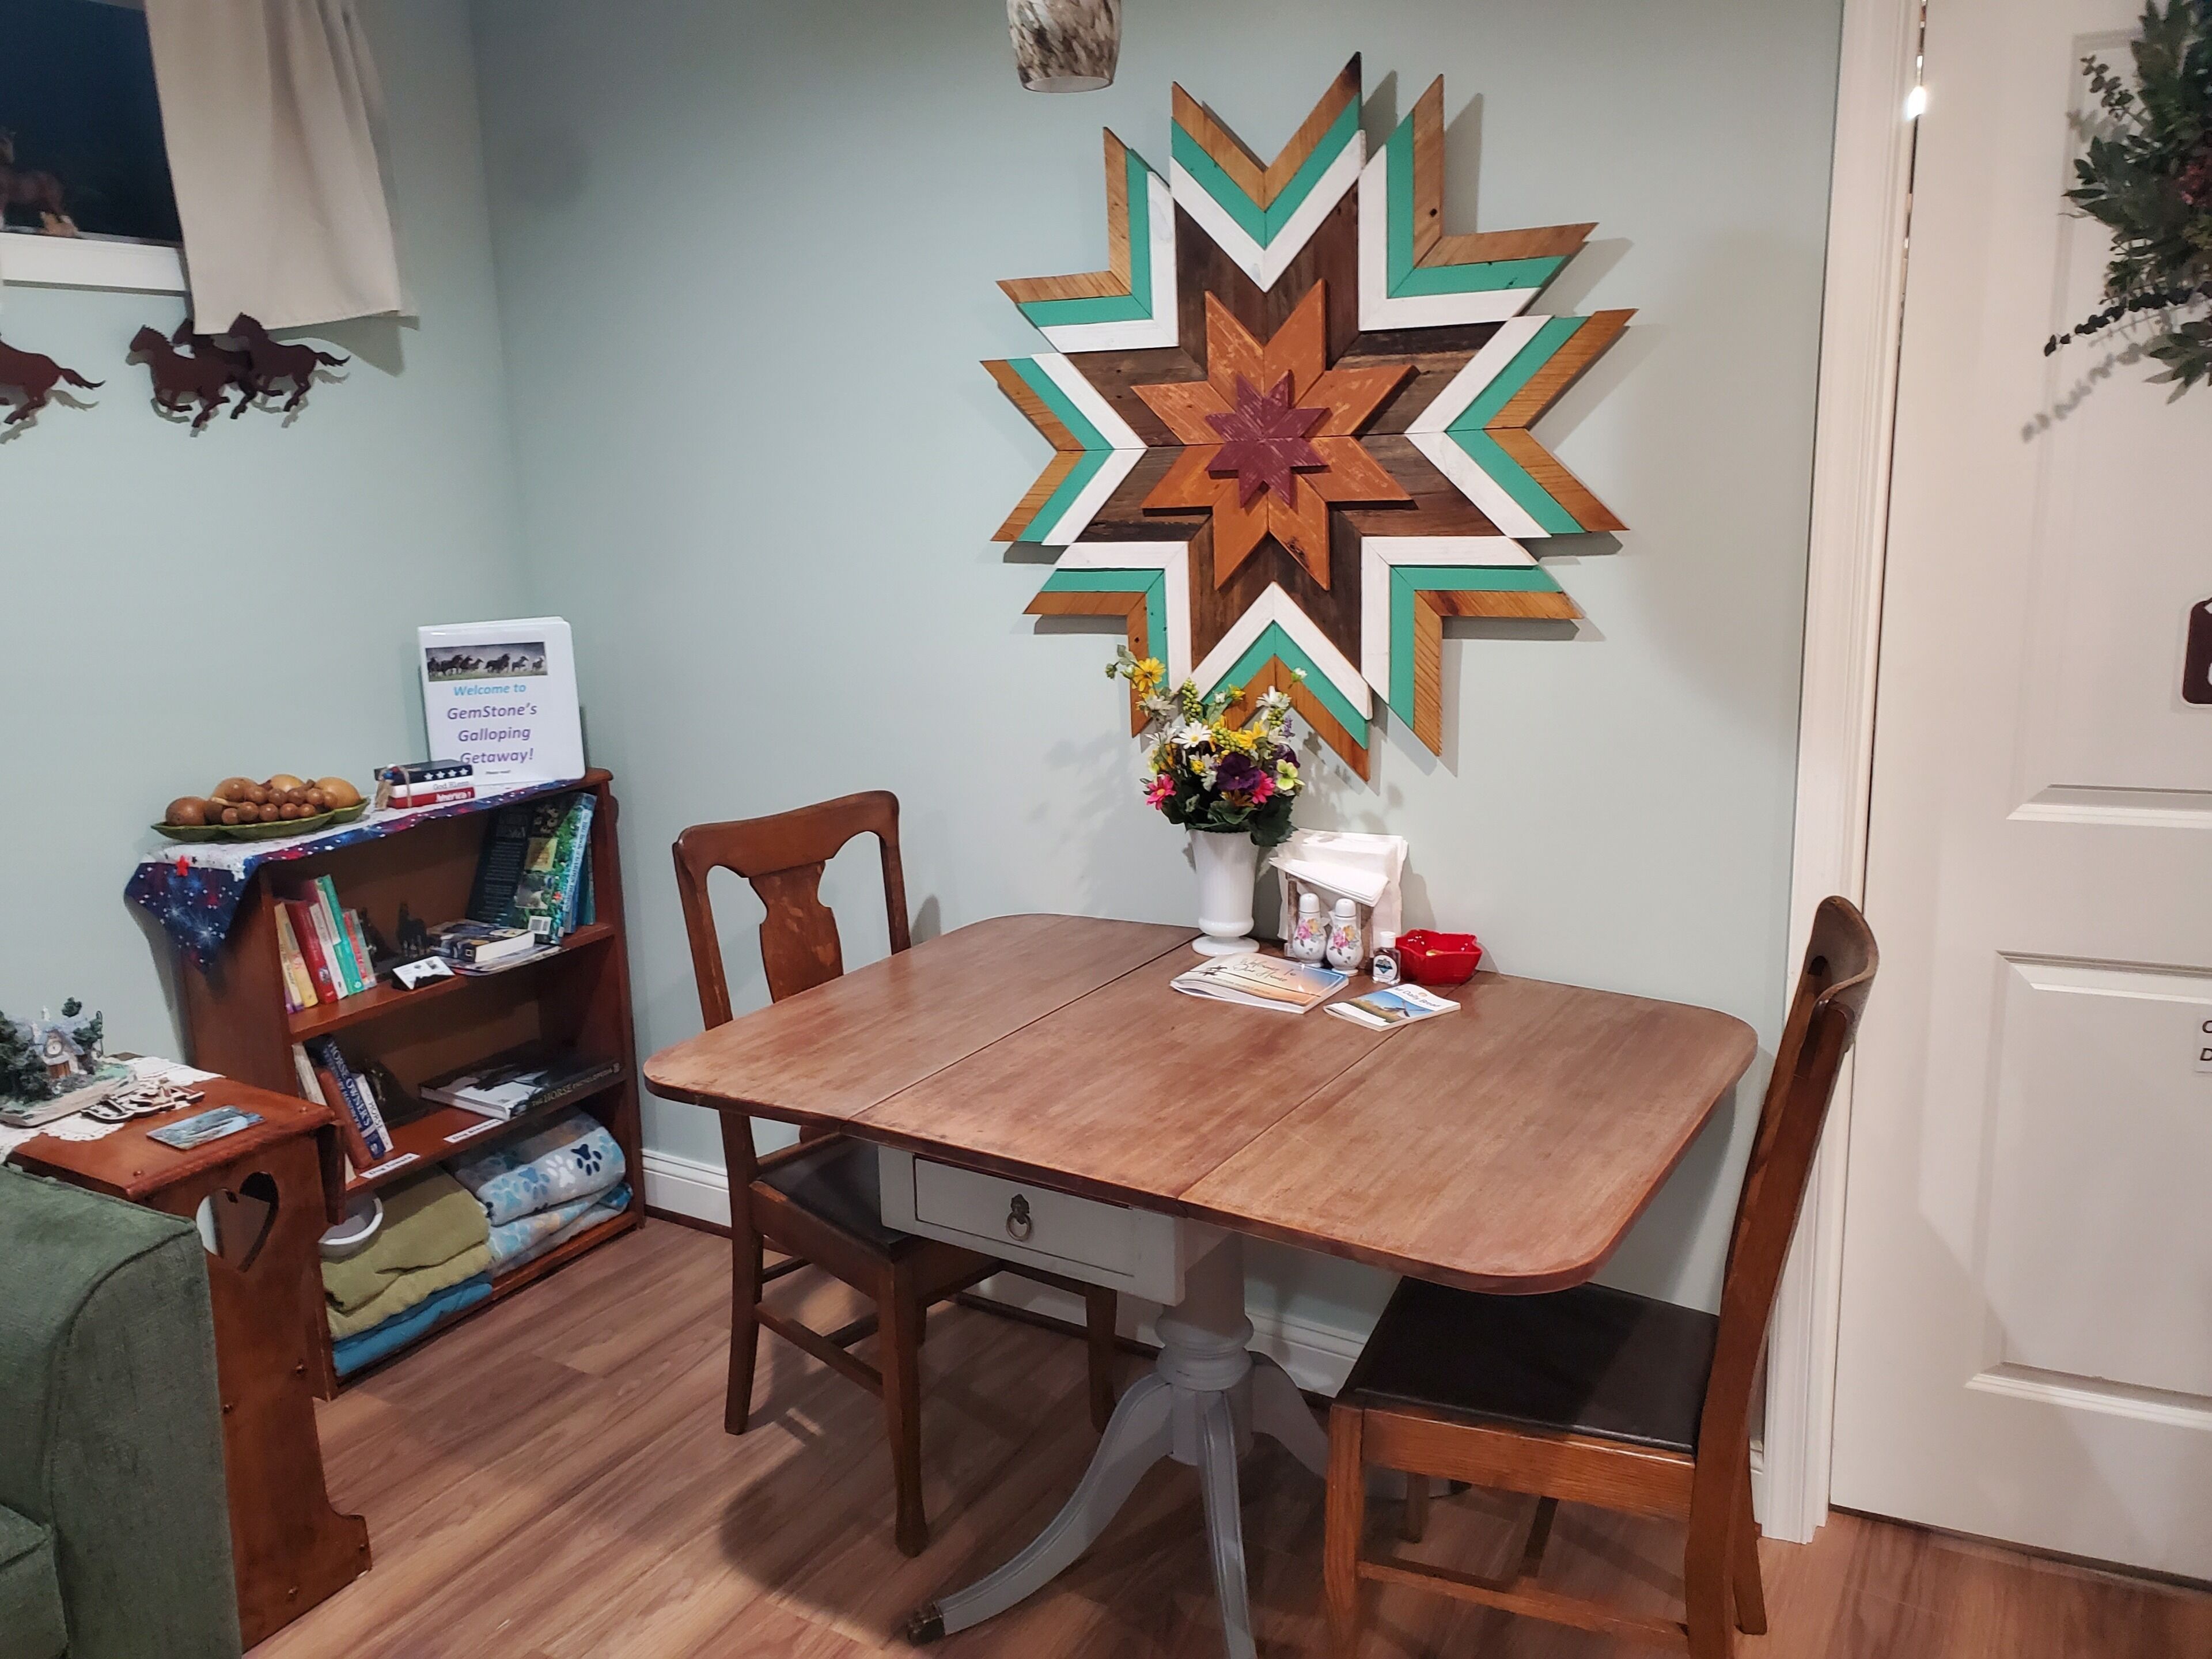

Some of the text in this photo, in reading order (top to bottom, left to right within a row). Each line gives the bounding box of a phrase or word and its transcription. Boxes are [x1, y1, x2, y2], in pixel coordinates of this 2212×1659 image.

[453, 684, 526, 696] Welcome to
[458, 726, 531, 742] Galloping
[460, 748, 533, 764] Getaway!
[544, 1084, 573, 1103] HORSE
